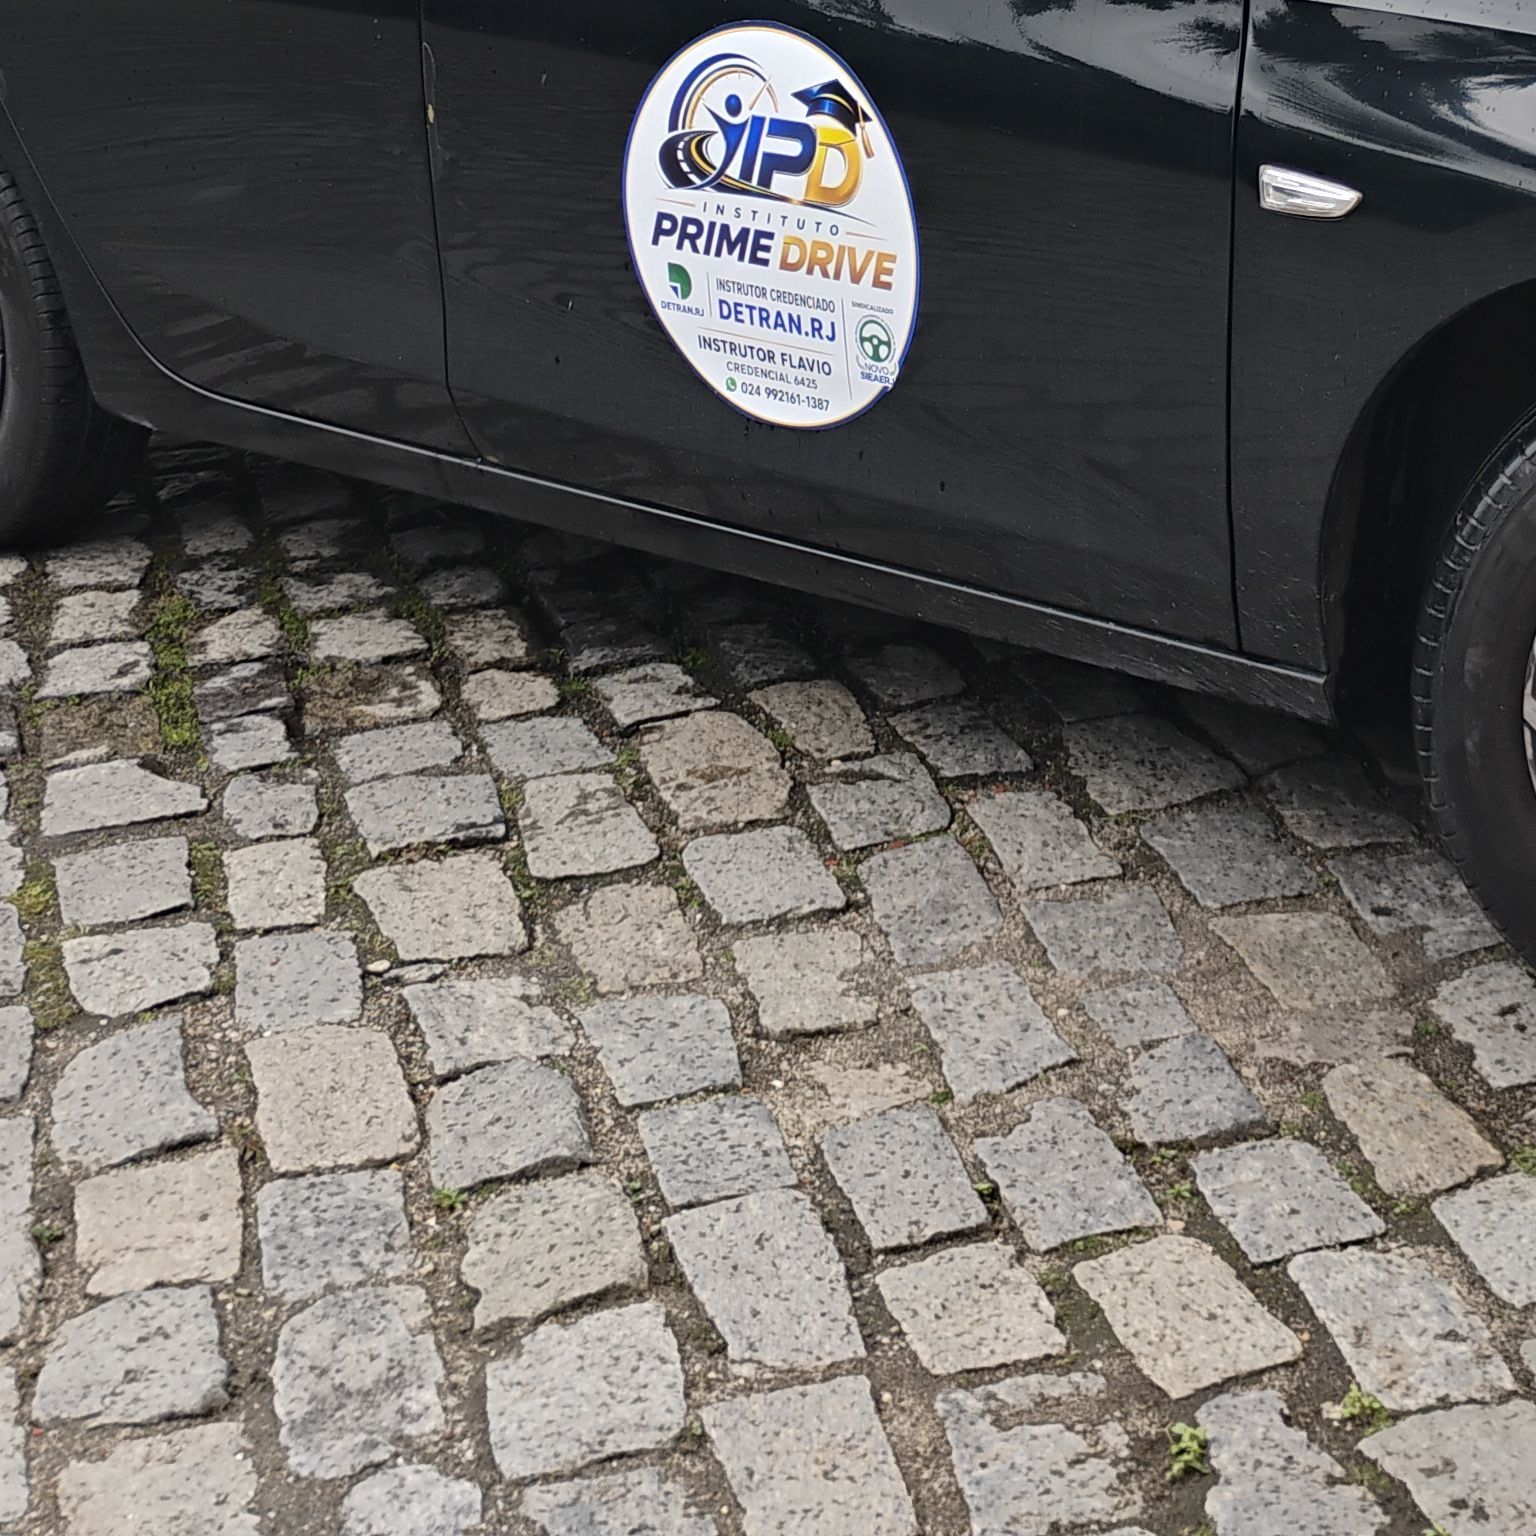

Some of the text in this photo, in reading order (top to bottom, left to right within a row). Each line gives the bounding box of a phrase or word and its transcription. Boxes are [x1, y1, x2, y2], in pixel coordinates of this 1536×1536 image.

[703, 201, 840, 237] INSTITUTO
[651, 211, 897, 291] PRIME DRIVE
[661, 300, 704, 316] DETRAN.RJ
[716, 277, 836, 313] INSTRUTOR CREDENCIADO
[718, 298, 837, 342] DETRAN.RJ
[697, 334, 832, 376] INSTRUTOR FLAVIO
[864, 362, 890, 376] NOVO
[726, 360, 818, 390] CREDENCIAL 6425
[741, 381, 830, 412] 024 992161-1387
